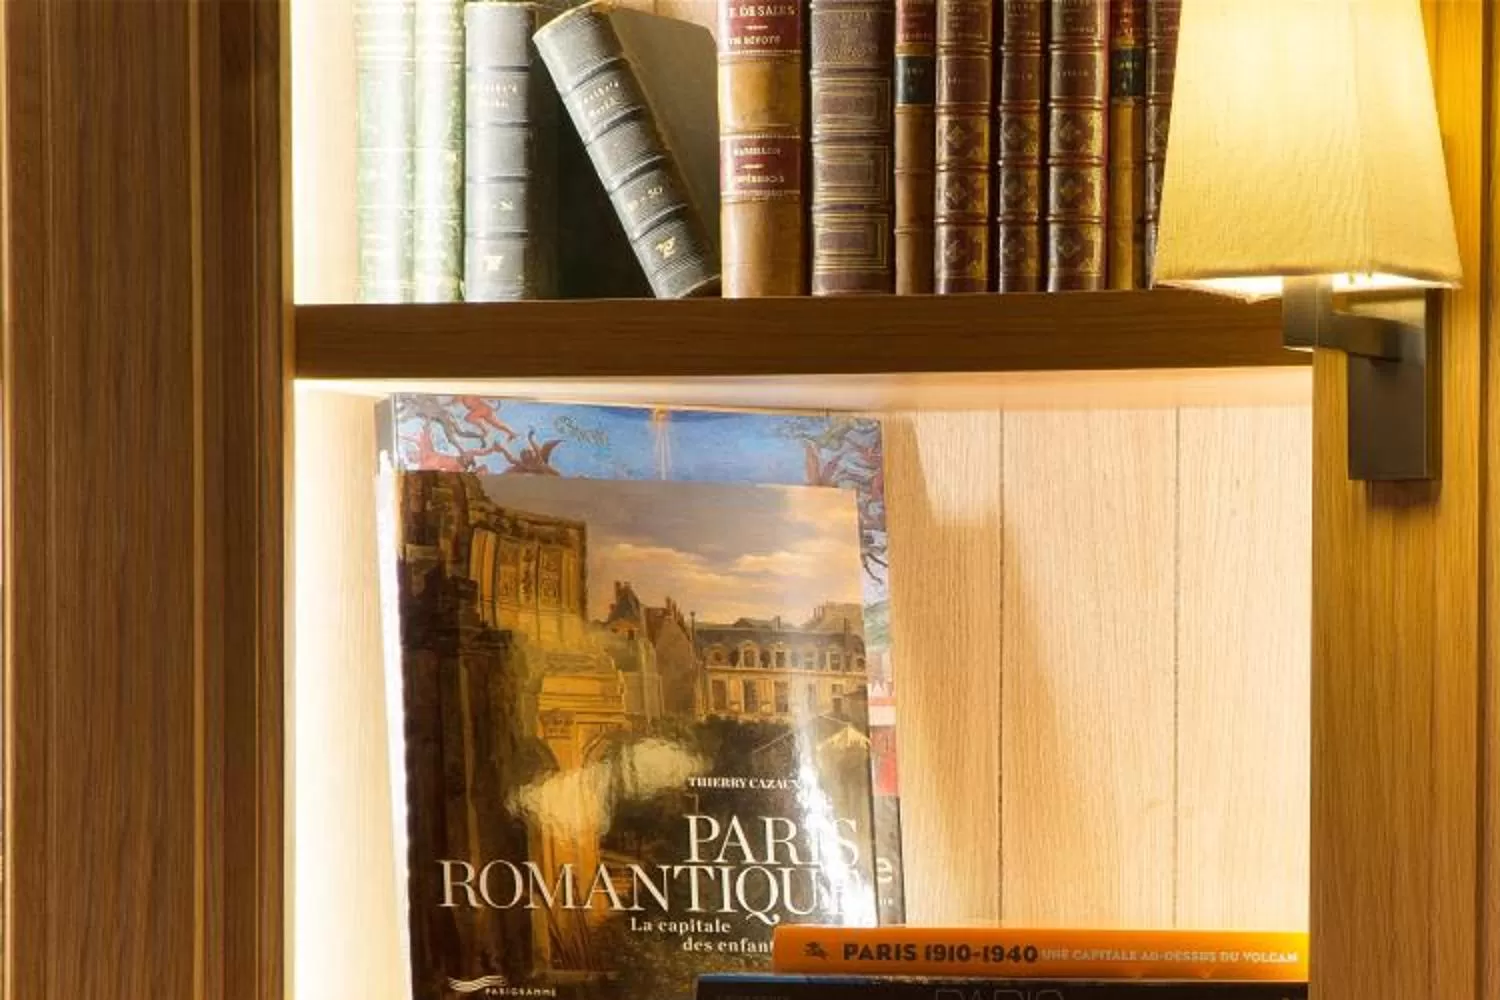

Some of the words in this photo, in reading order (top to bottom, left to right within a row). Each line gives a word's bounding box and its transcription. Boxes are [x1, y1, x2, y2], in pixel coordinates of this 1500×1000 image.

[688, 777, 746, 789] THIERRY
[683, 813, 860, 867] PARIS
[630, 916, 652, 932] La
[657, 917, 732, 936] capitale
[683, 936, 714, 952] des
[843, 943, 917, 961] PARIS
[925, 944, 1038, 963] 1910-1940
[1041, 947, 1070, 960] UNE
[1072, 949, 1137, 961] CAPITALE
[1220, 951, 1240, 962] DU
[1243, 951, 1299, 964] VOLCAN
[484, 987, 557, 998] PARIGRAMME
